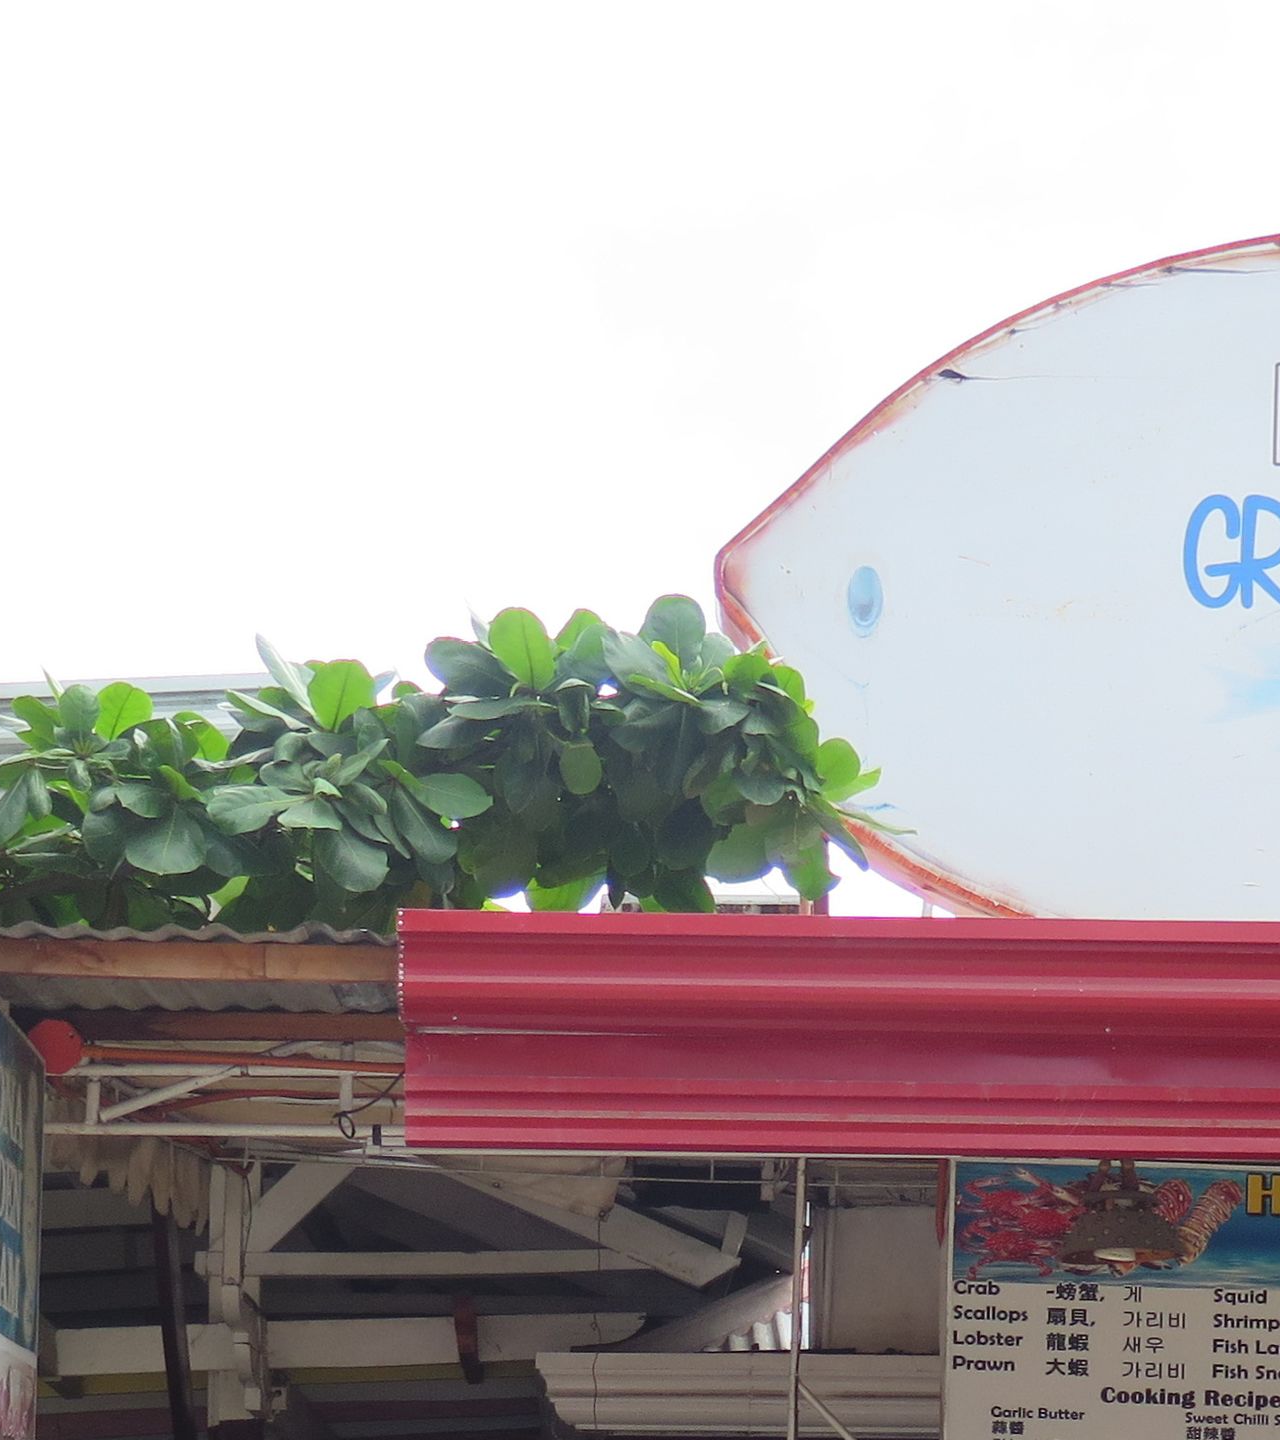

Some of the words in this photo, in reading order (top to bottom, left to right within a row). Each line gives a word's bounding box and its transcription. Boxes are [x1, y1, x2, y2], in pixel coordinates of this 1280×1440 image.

[953, 1280, 1000, 1295] Crab
[1123, 1285, 1142, 1302] 게
[1213, 1288, 1267, 1306] Squid
[953, 1305, 1028, 1323] Scallops
[1123, 1311, 1186, 1329] 가리비
[1213, 1313, 1280, 1332] Shrimp
[953, 1330, 1023, 1347] Lobster
[1046, 1333, 1089, 1351] 龍蝦
[1122, 1336, 1165, 1353] 새우
[1212, 1338, 1248, 1355] Fish
[952, 1355, 1015, 1372] Prawn
[1045, 1358, 1089, 1377] 大蝦
[1122, 1361, 1186, 1379] 가리비
[1211, 1364, 1248, 1380] Fish
[1100, 1386, 1196, 1409] Cooking
[990, 1406, 1033, 1419] Garlic
[1038, 1408, 1085, 1421] Butter
[1185, 1412, 1228, 1425] Sweet
[1233, 1414, 1269, 1427] Chilli
